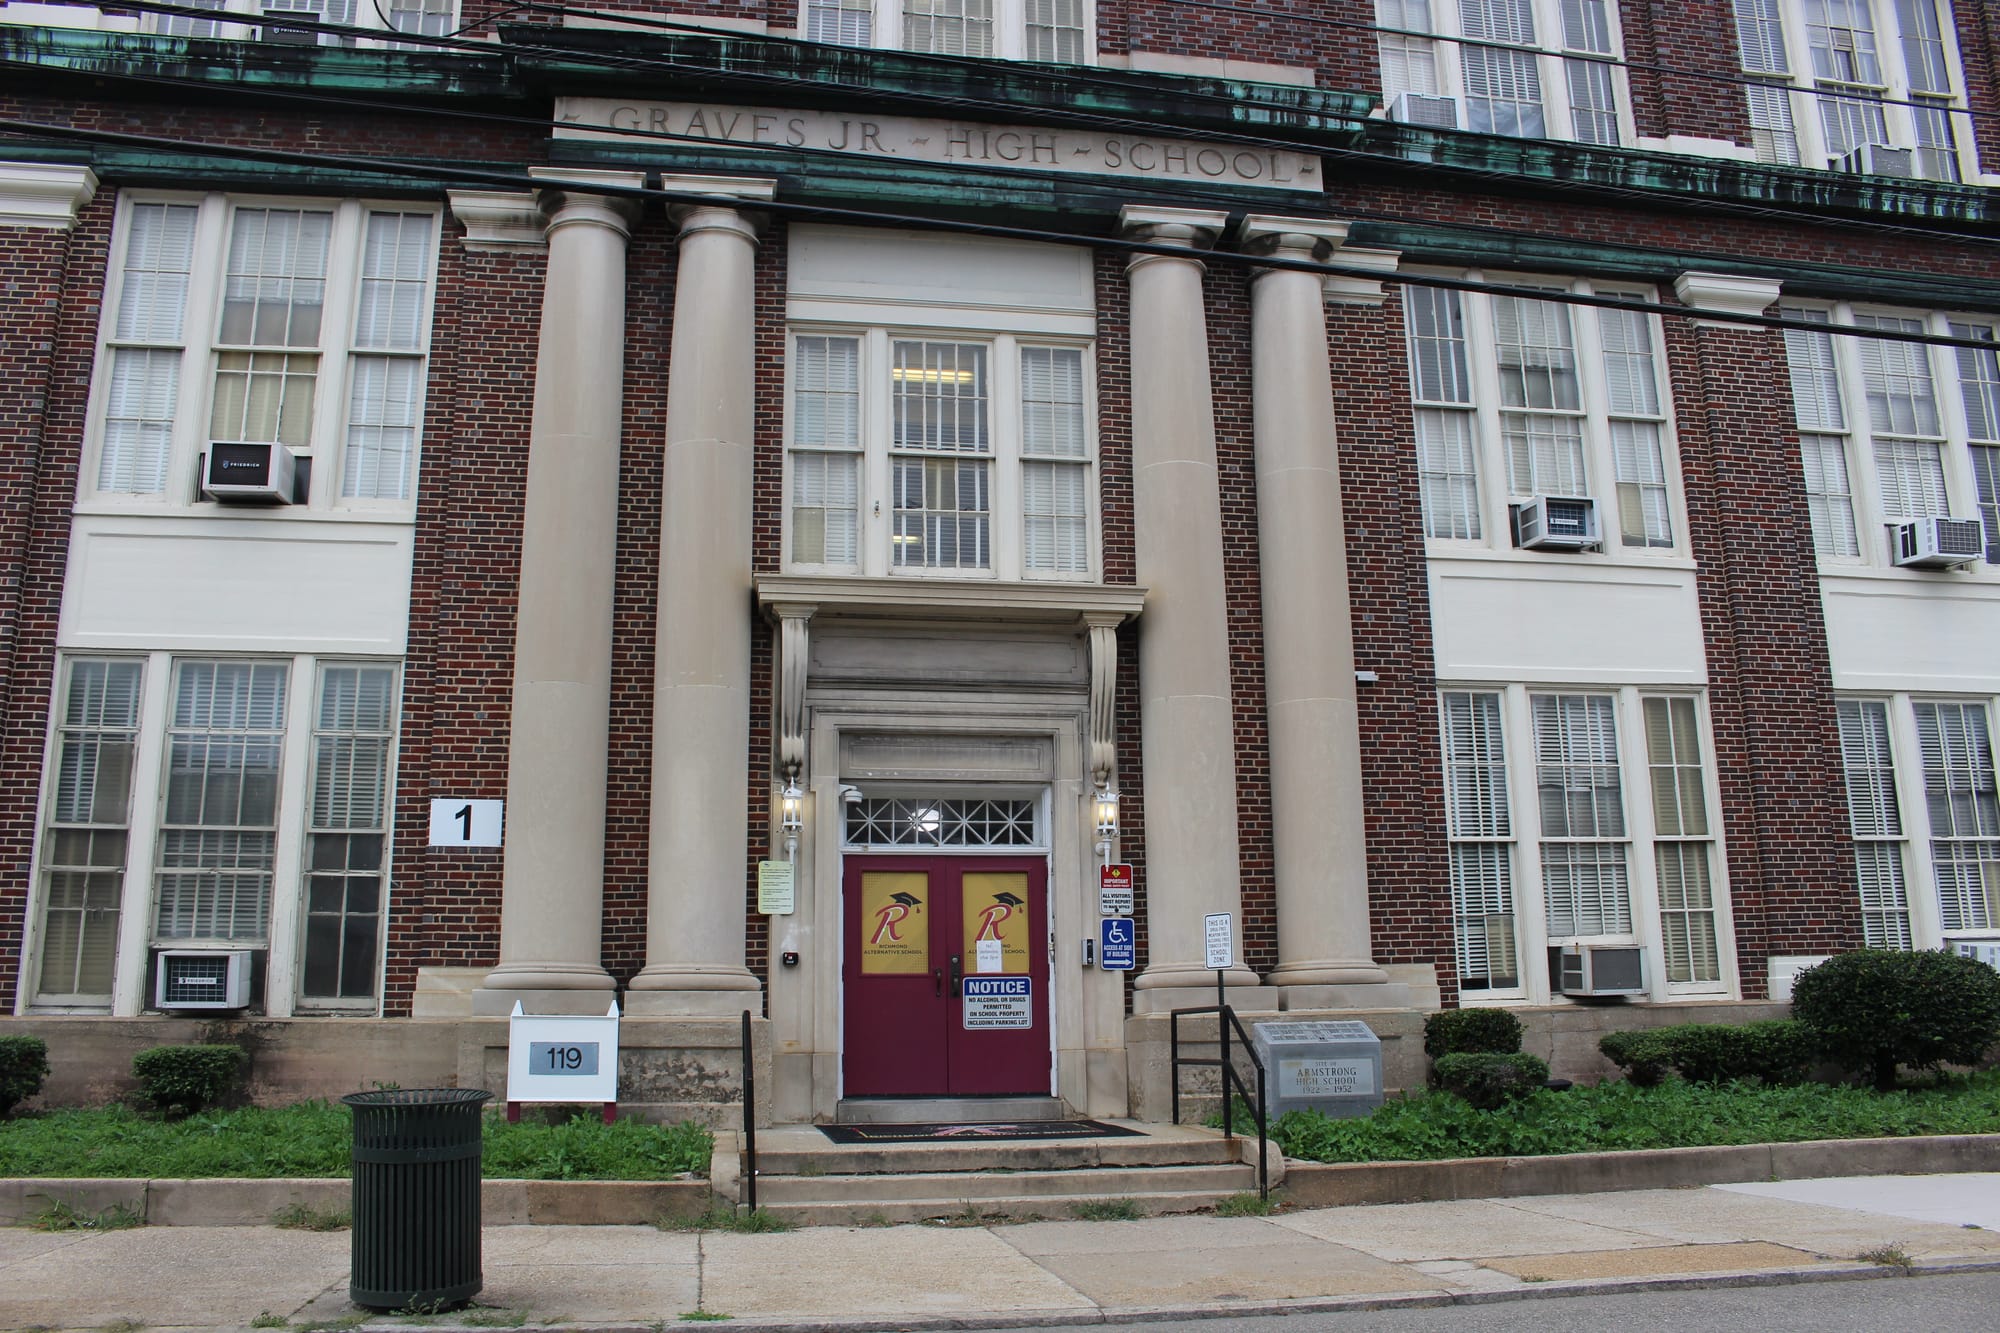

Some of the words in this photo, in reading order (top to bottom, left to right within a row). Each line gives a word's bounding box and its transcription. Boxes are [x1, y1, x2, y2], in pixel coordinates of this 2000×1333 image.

[609, 106, 806, 147] GRAVES
[828, 119, 896, 153] JR.
[943, 127, 1060, 165] HIGH
[1104, 140, 1292, 183] SCHOOL
[455, 804, 472, 841] 1
[968, 981, 1026, 994] NOTICE
[547, 1047, 582, 1070] 119
[1297, 1067, 1357, 1077] ARMSTRONG
[1296, 1077, 1318, 1086] HIGH
[1322, 1076, 1357, 1085] SCHOOL
[1302, 1086, 1321, 1094] 1922
[1334, 1085, 1352, 1093] 1952
